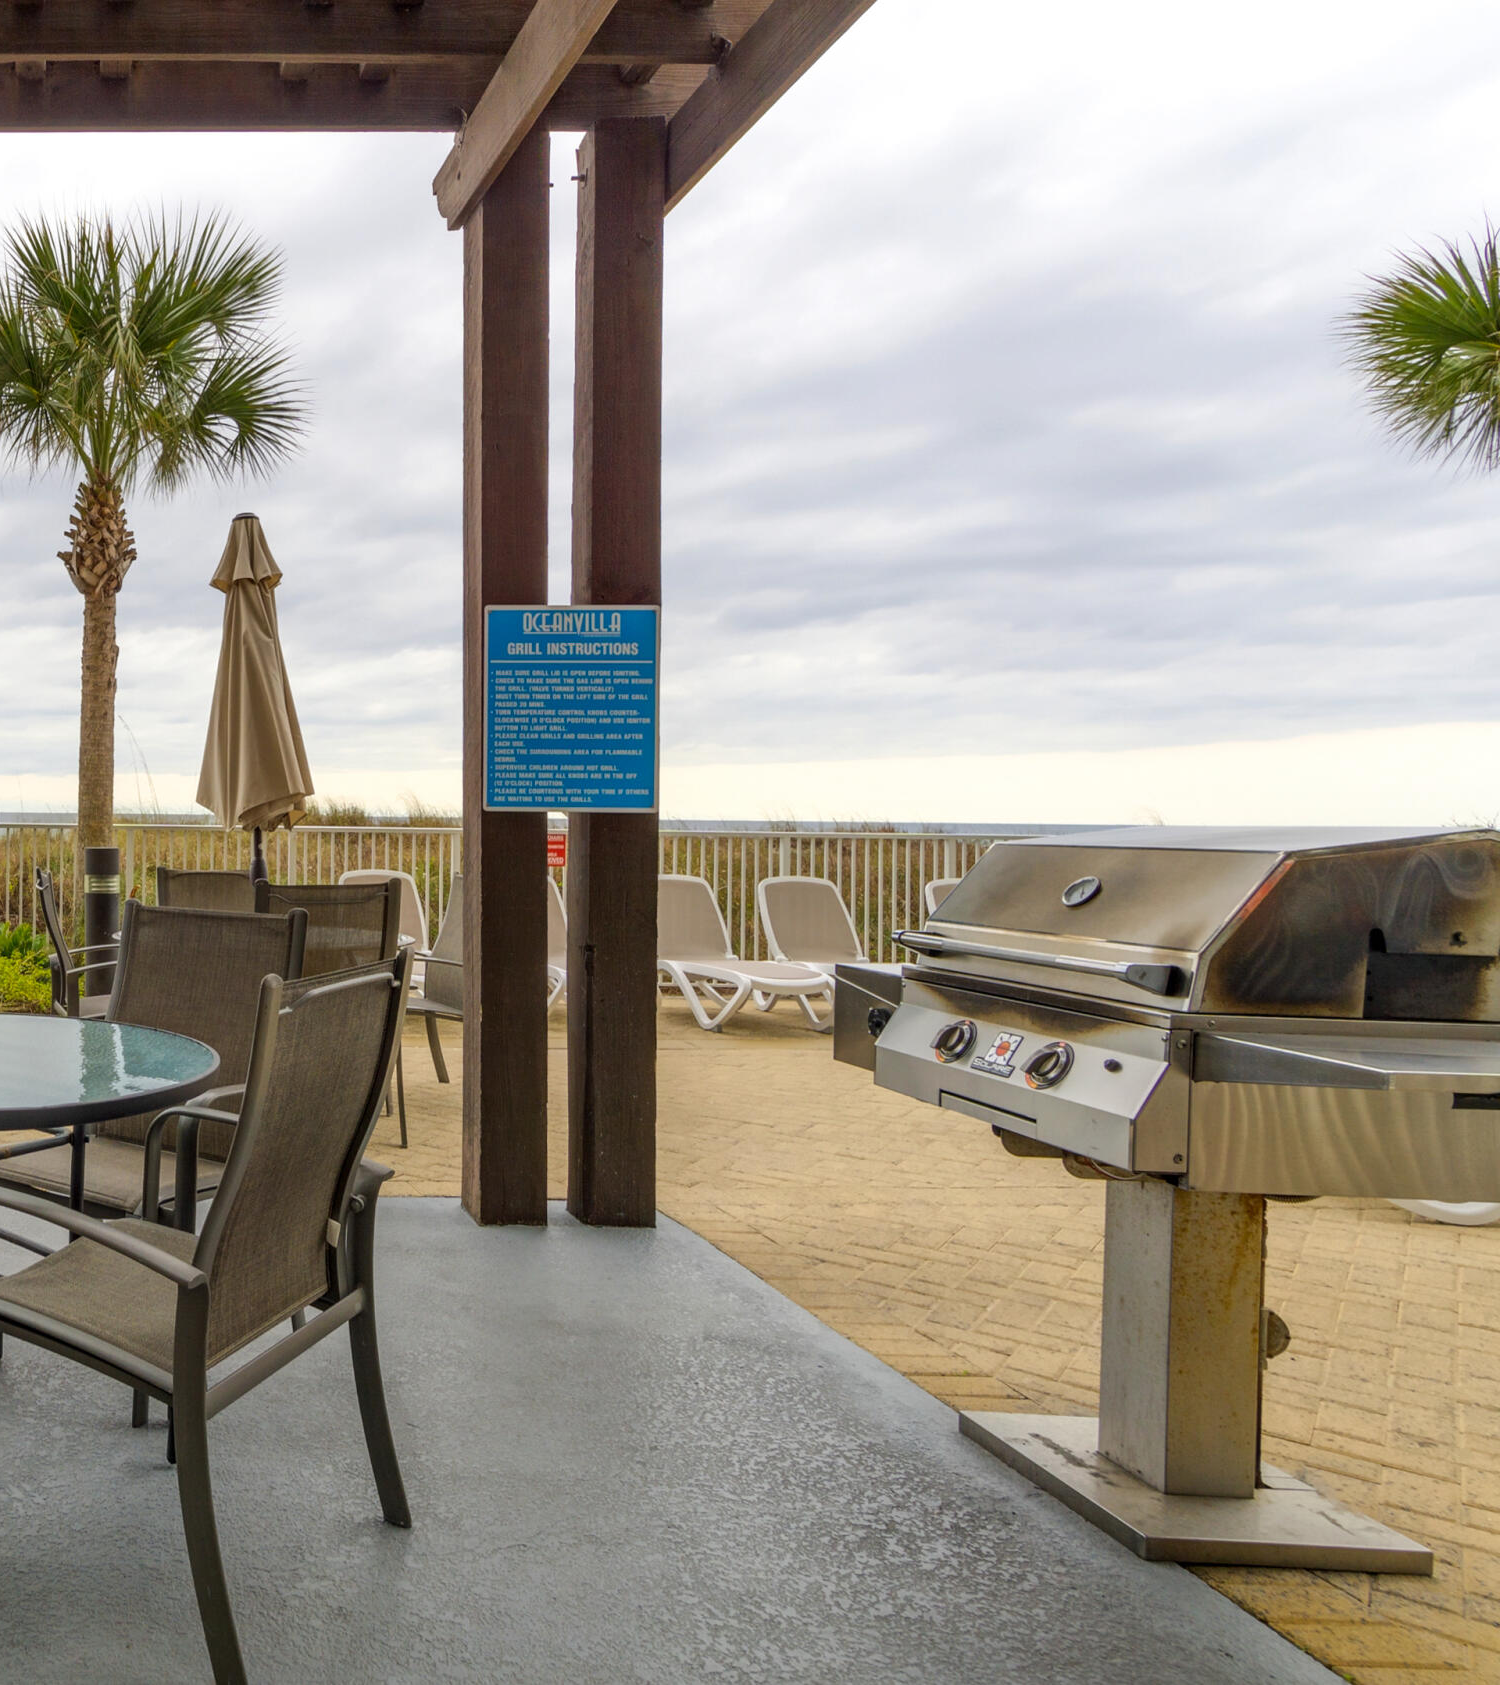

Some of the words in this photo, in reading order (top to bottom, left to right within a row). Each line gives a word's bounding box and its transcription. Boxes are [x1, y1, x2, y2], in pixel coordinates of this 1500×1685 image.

[522, 612, 621, 634] OCEANVILLA
[508, 642, 542, 655] GRILL
[547, 642, 639, 655] INSTRUCTIONS
